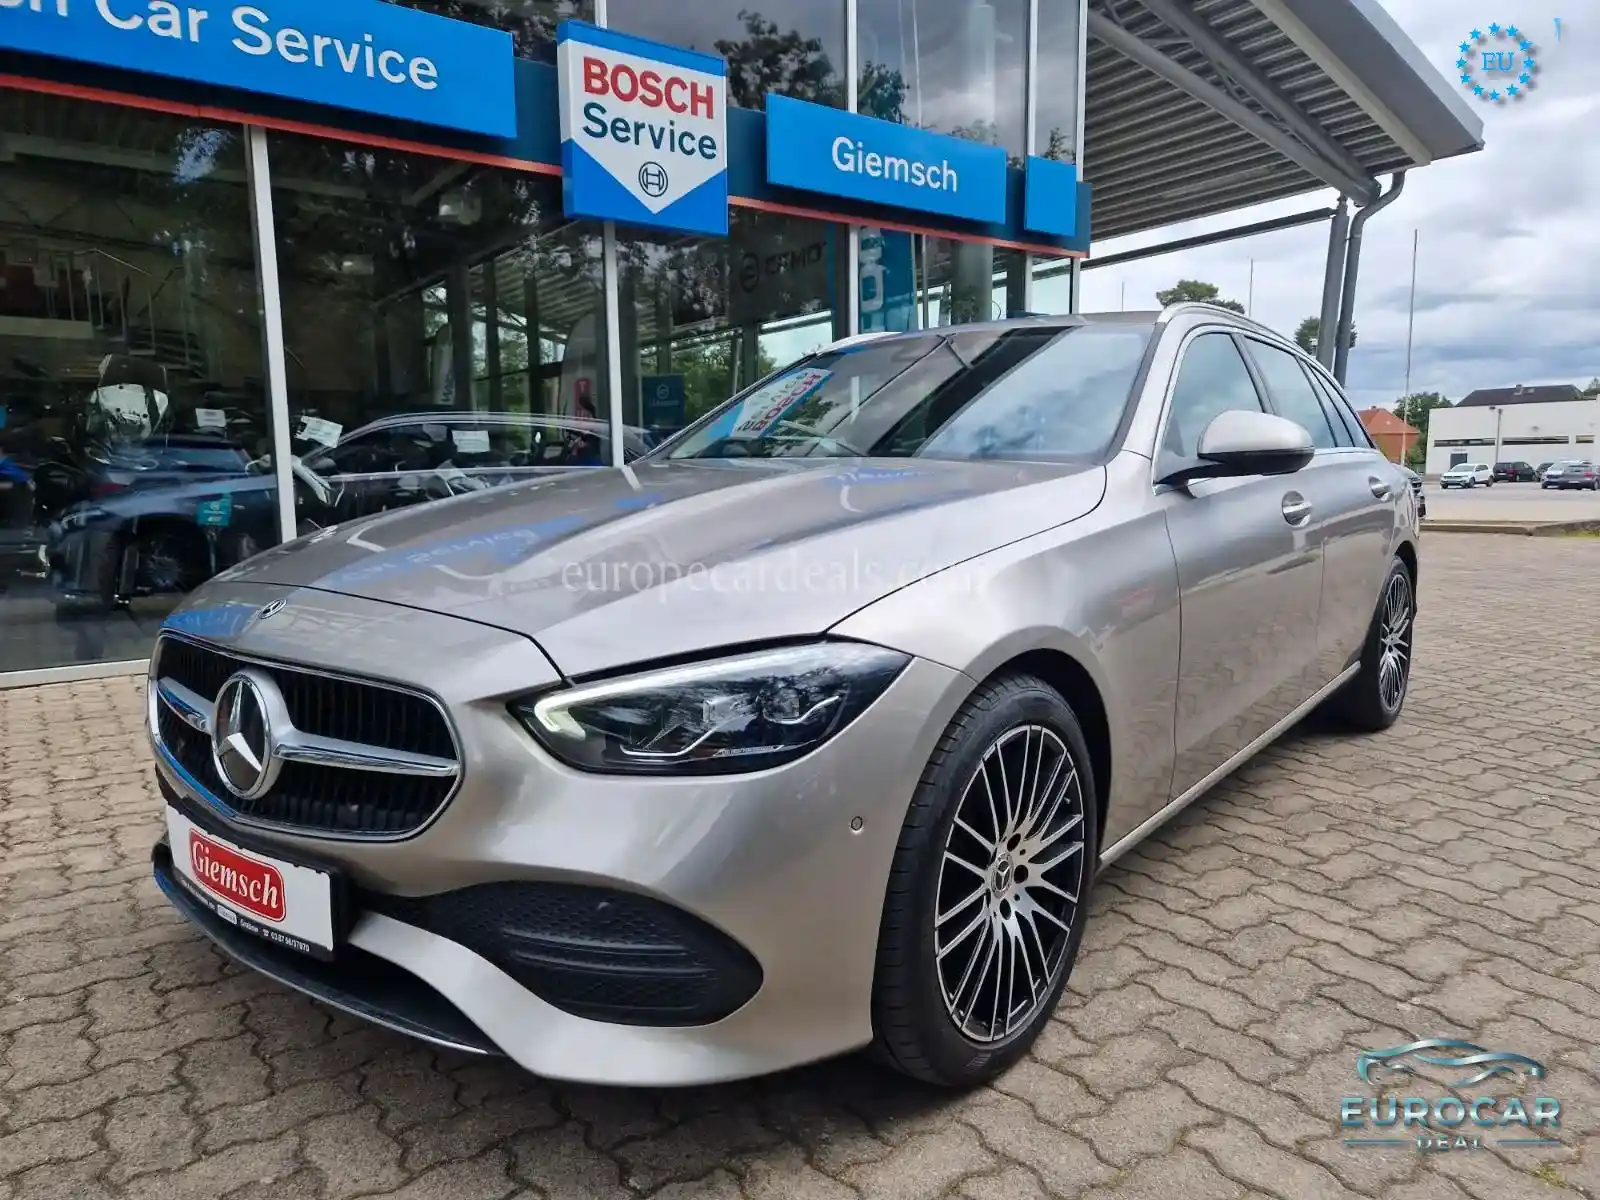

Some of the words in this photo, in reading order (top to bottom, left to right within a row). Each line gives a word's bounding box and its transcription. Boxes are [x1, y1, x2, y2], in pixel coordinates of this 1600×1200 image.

[99, 0, 207, 43] Car
[231, 6, 439, 91] Service
[582, 56, 715, 120] BOSCH
[582, 102, 717, 160] Service
[831, 135, 958, 193] Giemsch
[192, 840, 280, 910] Giemsch
